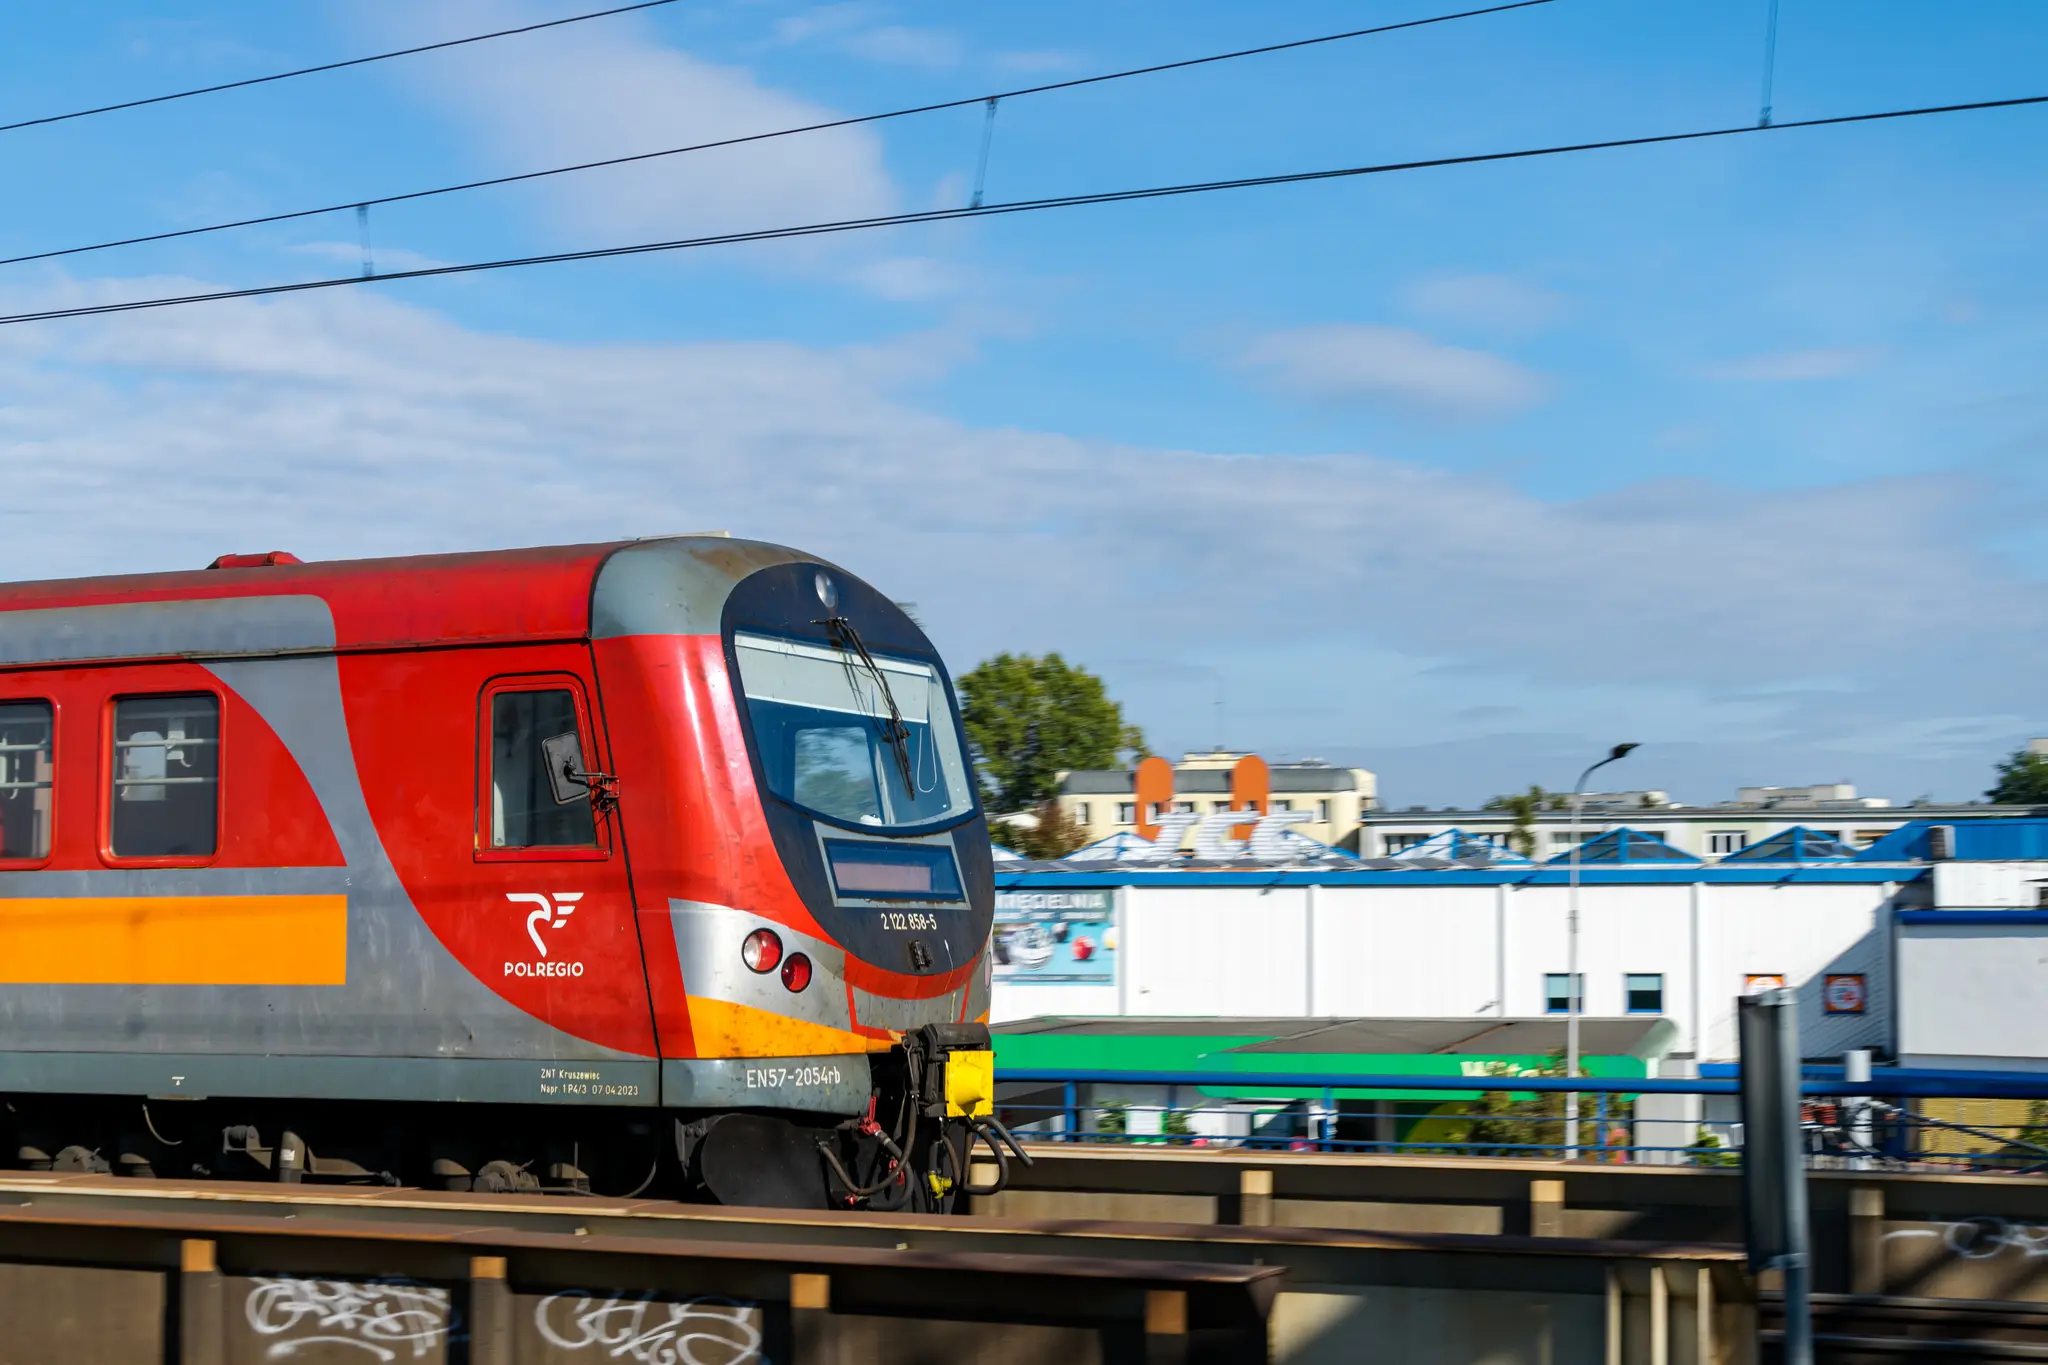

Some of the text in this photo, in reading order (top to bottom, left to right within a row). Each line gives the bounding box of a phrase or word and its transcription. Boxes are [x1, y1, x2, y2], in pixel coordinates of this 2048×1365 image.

[881, 913, 937, 930] 2 122 858-5
[504, 961, 584, 977] POLREGIO
[541, 1068, 556, 1079] ZNT
[746, 1066, 841, 1088] EN57-2054rb
